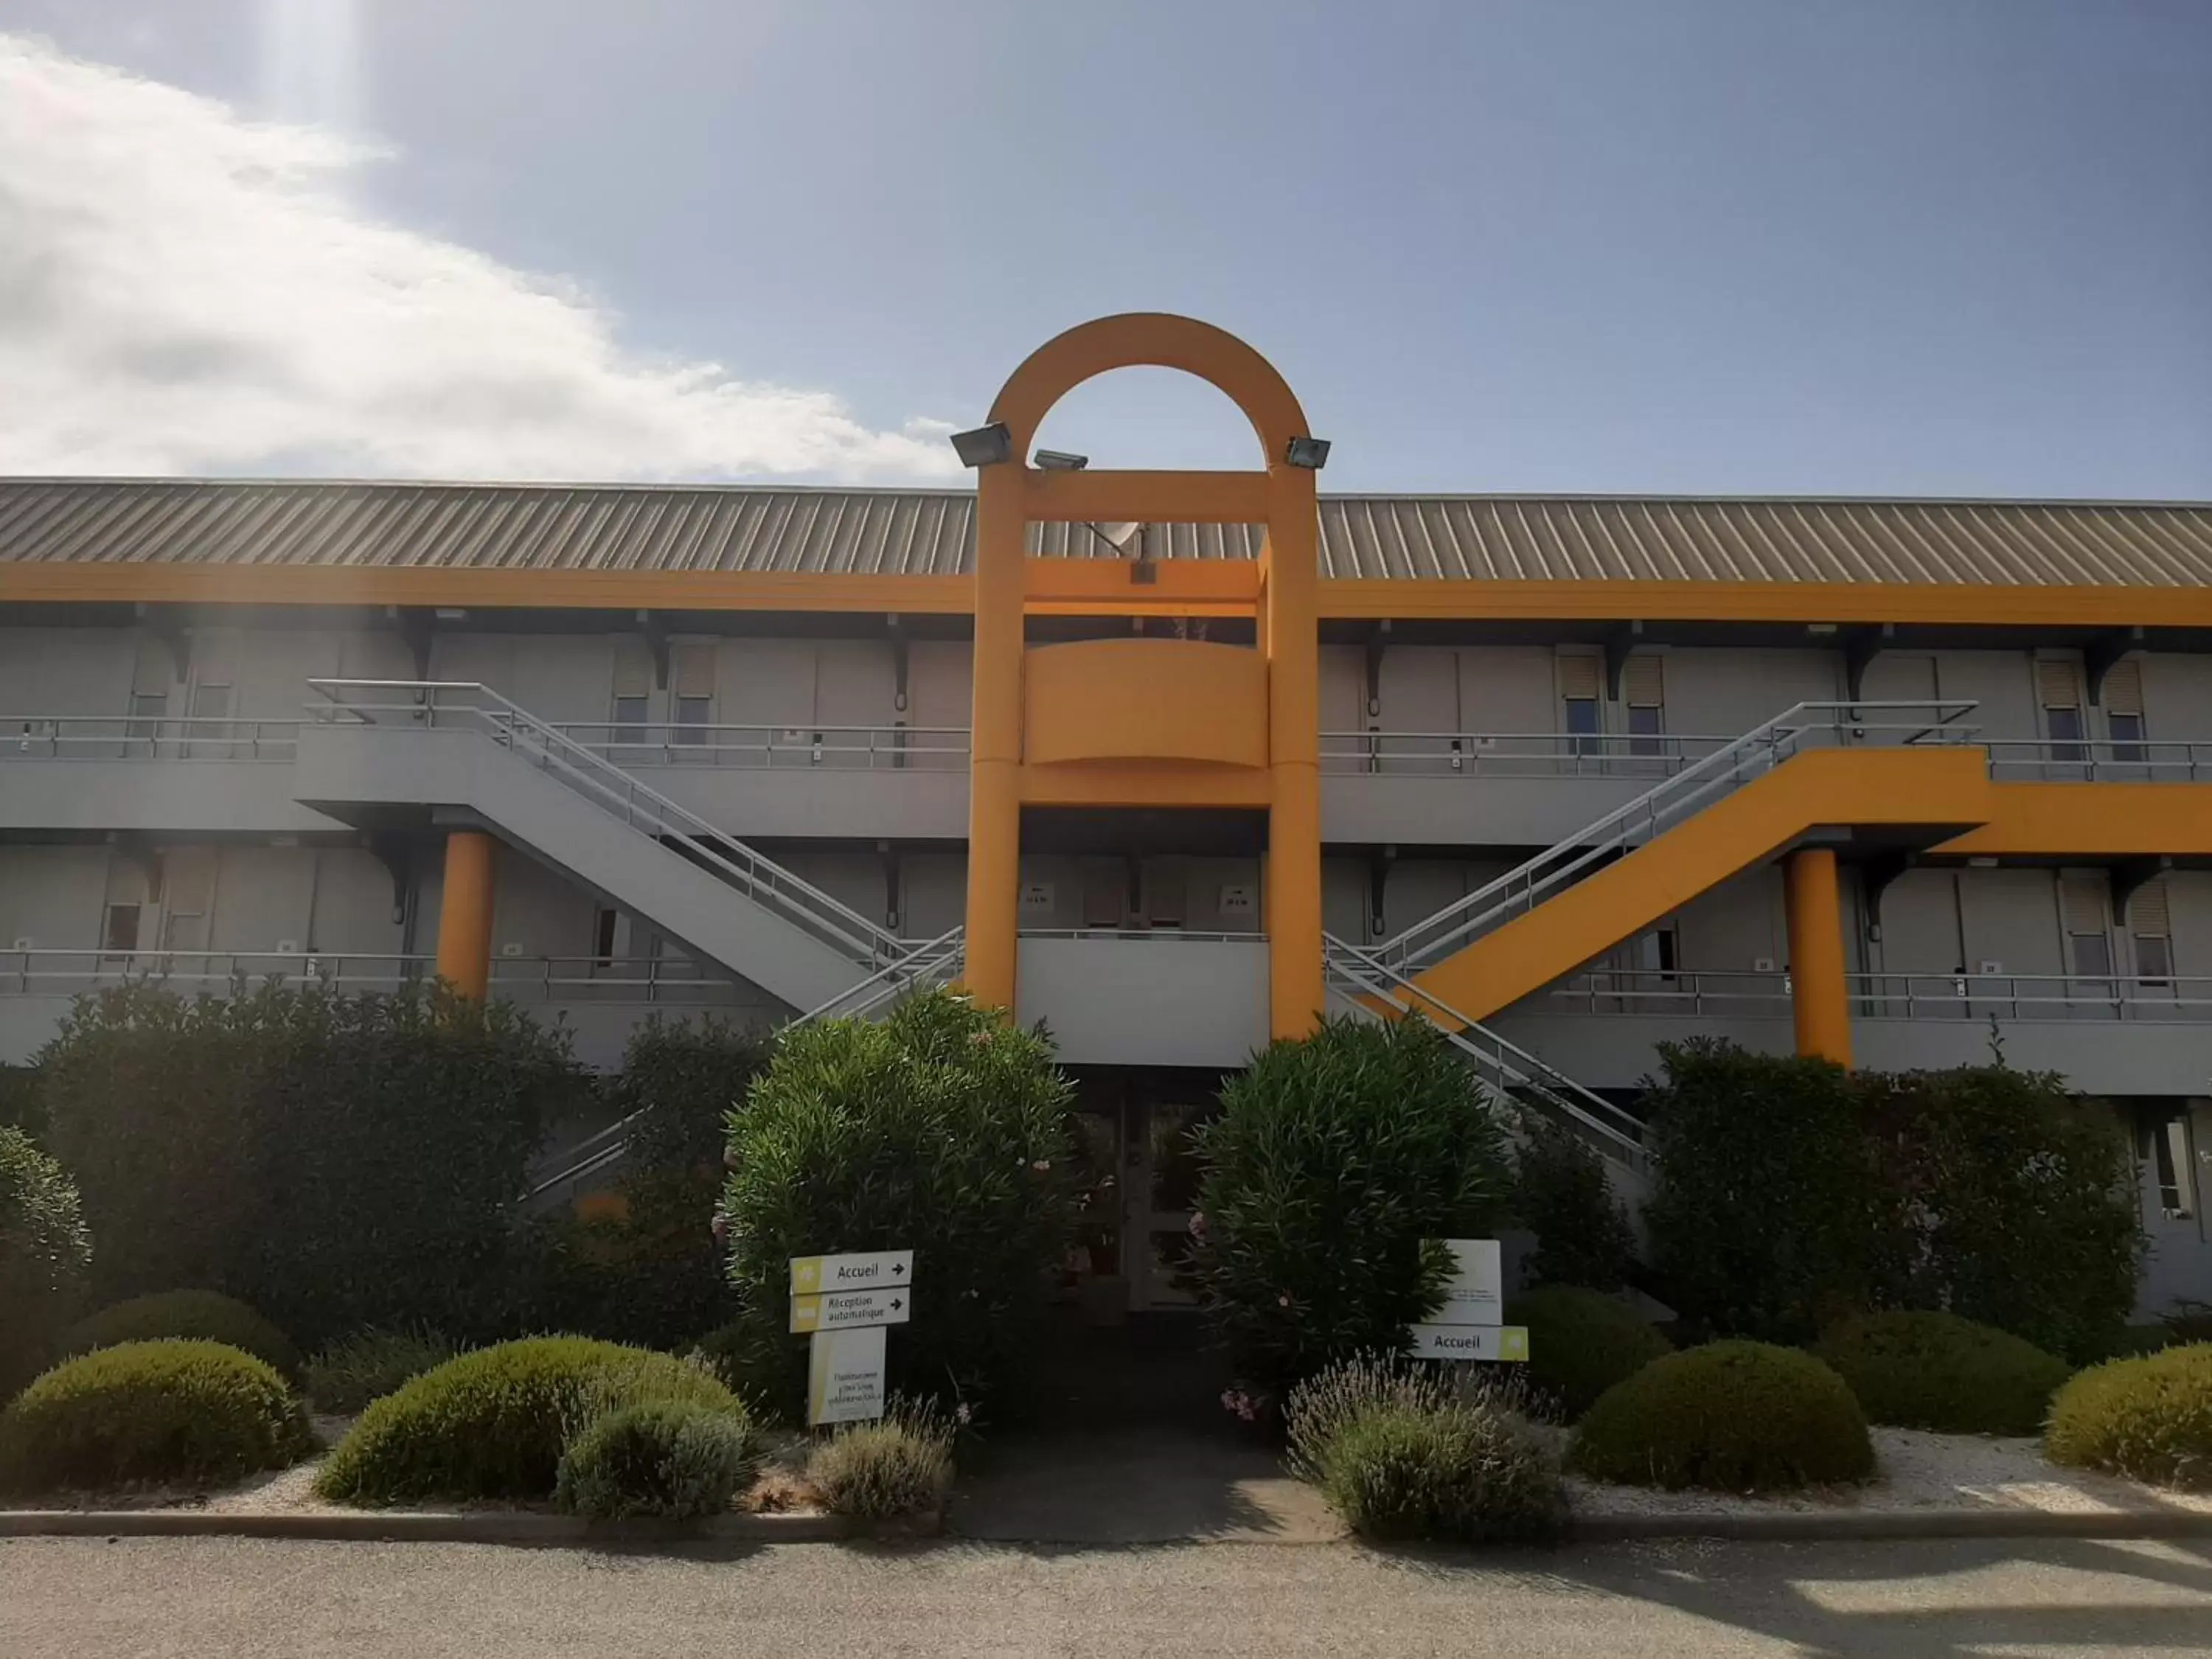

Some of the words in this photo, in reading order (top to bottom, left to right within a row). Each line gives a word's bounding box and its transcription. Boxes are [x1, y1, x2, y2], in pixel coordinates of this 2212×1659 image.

[838, 1262, 878, 1279] Accueil
[828, 1295, 873, 1309] Réception
[828, 1310, 885, 1321] automatique
[1434, 1334, 1481, 1349] Accueil
